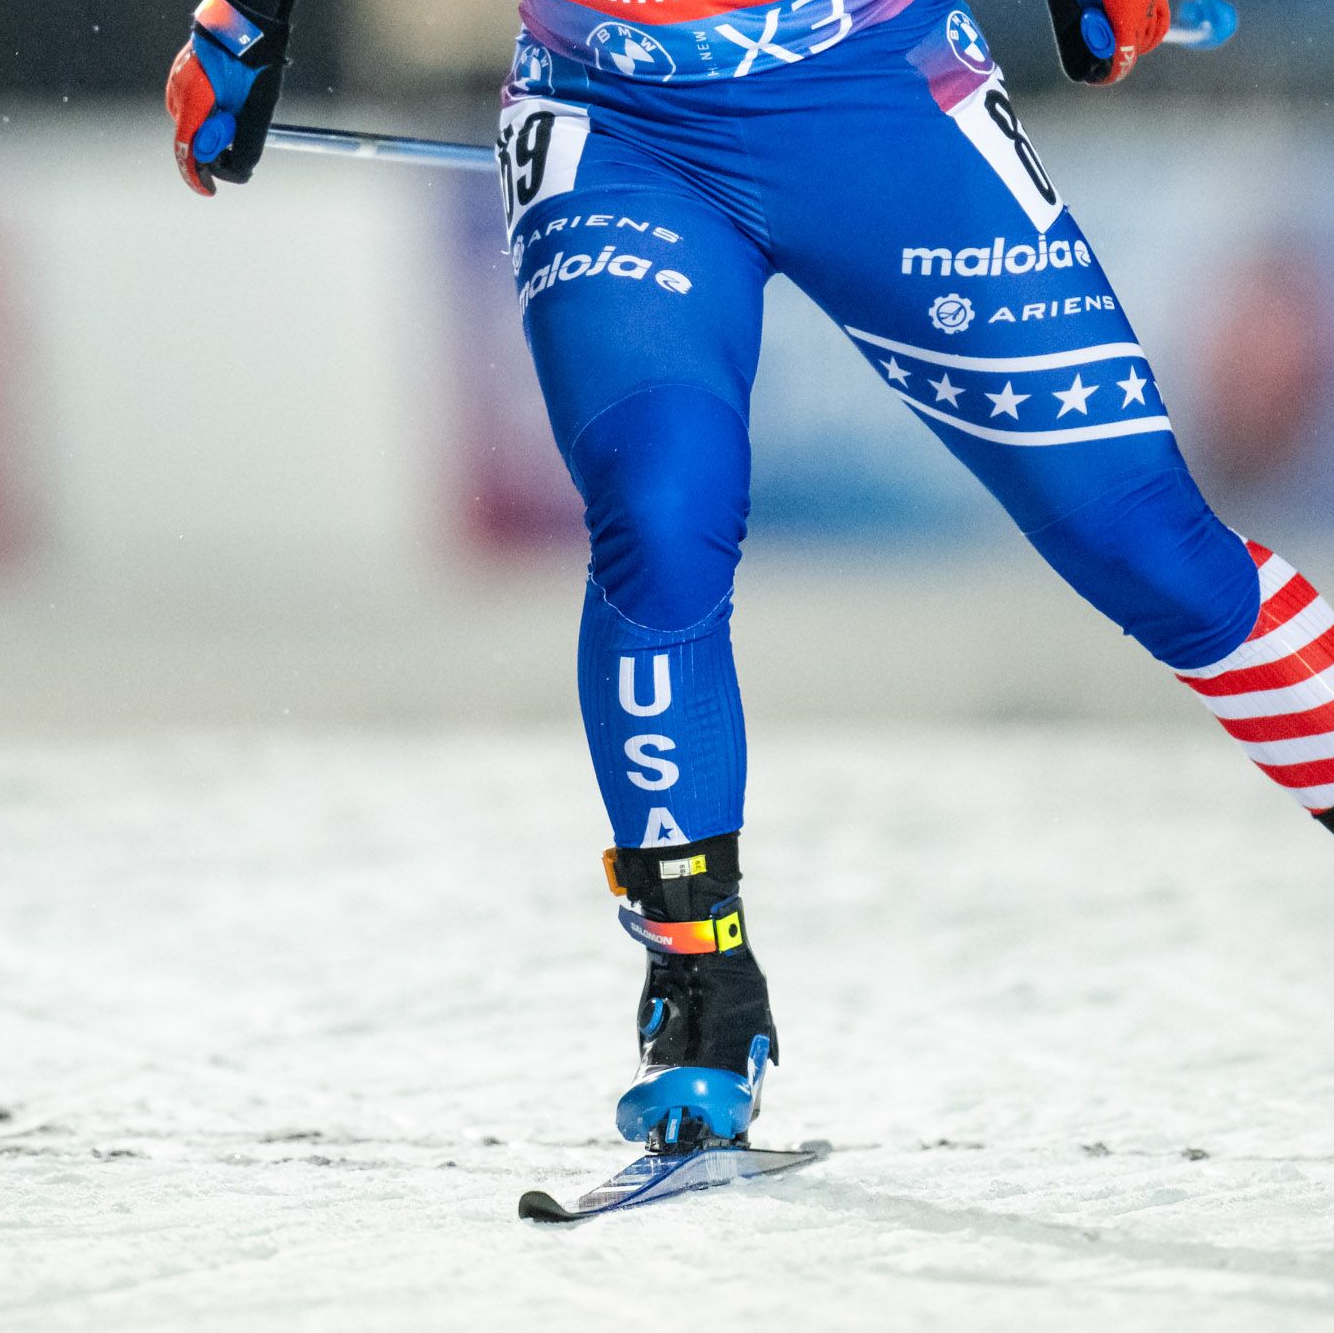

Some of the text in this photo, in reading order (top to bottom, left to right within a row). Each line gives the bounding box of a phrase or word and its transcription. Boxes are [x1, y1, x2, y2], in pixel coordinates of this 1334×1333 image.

[596, 25, 658, 53] BMW
[692, 30, 714, 61] NEW
[983, 89, 1057, 206] 8
[527, 215, 681, 248] ARIENS
[901, 234, 1073, 277] maloja
[987, 295, 1116, 324] ARIENS
[618, 653, 691, 849] USA
